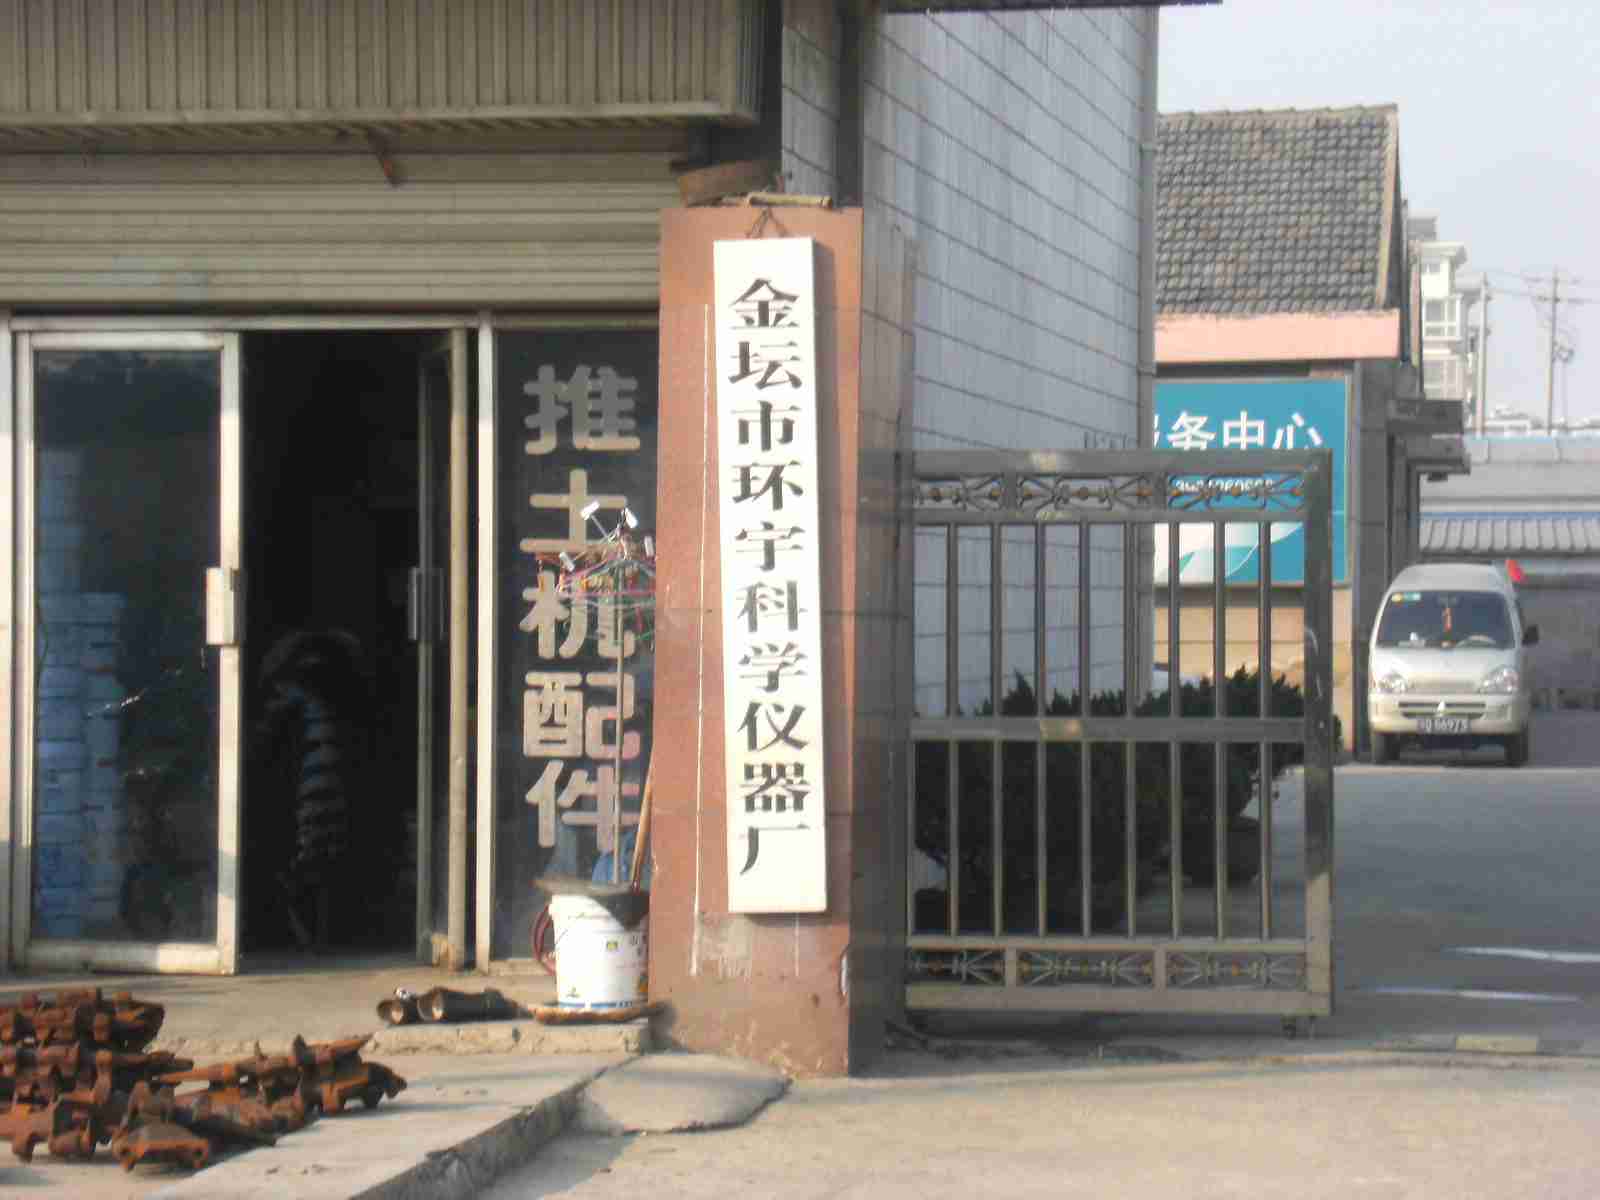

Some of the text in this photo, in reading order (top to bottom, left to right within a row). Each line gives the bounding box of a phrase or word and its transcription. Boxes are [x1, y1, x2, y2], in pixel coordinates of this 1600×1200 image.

[520, 364, 641, 852] 推土机配件
[728, 277, 811, 875] 金坛市环宇科学仪器厂
[1153, 410, 1323, 450] 务中心
